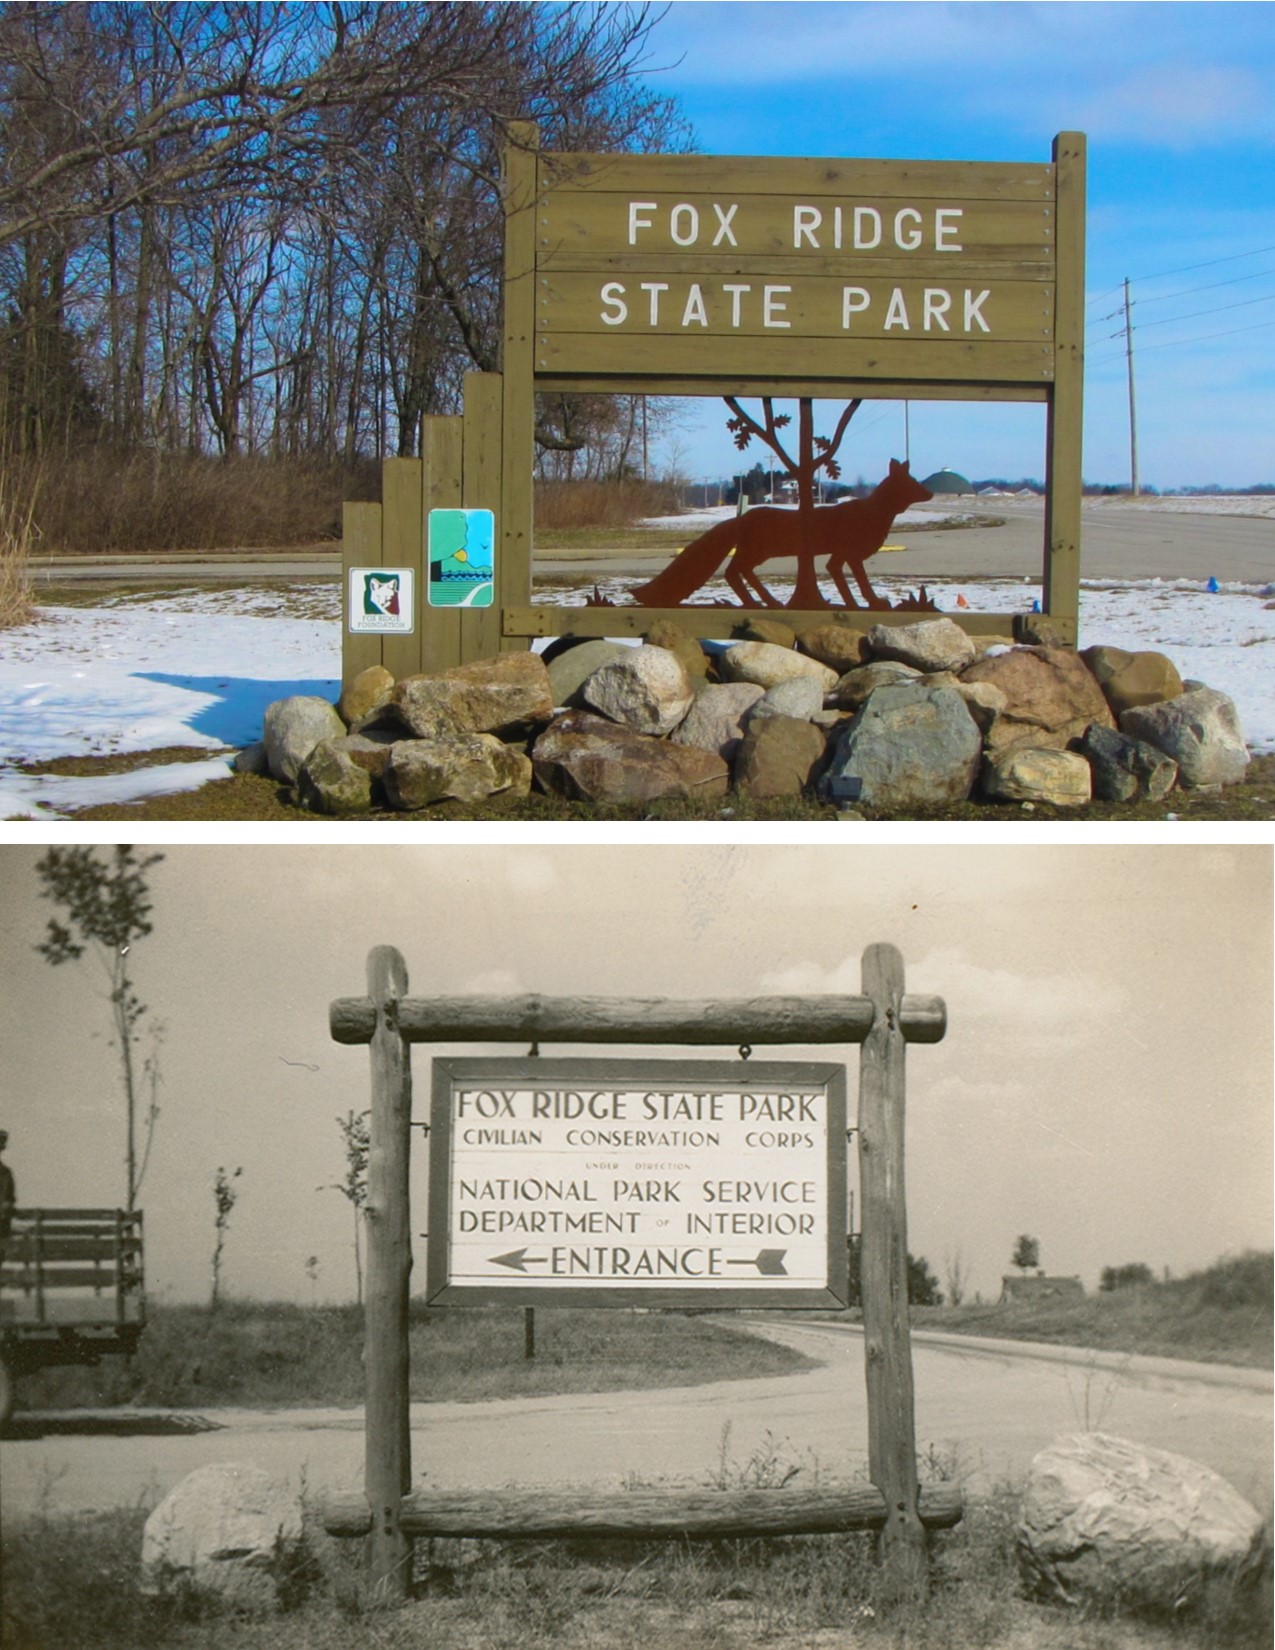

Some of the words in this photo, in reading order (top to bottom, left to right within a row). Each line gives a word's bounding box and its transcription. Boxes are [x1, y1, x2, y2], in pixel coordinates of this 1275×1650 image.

[628, 202, 738, 246] FOX
[793, 205, 963, 252] RIDGE
[600, 282, 791, 328] STATE
[842, 286, 991, 333] PARK
[457, 1091, 517, 1118] FOX
[532, 1091, 627, 1120] RIDGE
[643, 1093, 724, 1121] STATE
[739, 1094, 818, 1122] PARK
[463, 1128, 542, 1145] CIVILIAN
[566, 1129, 720, 1147] CONSERVATION
[745, 1131, 814, 1148] CORPS
[585, 1162, 620, 1170] UNDER
[635, 1162, 692, 1170] DIRECTION
[459, 1179, 597, 1202] NATIONAL
[613, 1180, 681, 1202] PARK
[703, 1180, 817, 1203] SERVICE
[459, 1210, 641, 1233] DEPARTMENT
[656, 1219, 670, 1227] OF
[687, 1212, 815, 1235] INTERIOR
[552, 1246, 723, 1276] ENTRANCE
